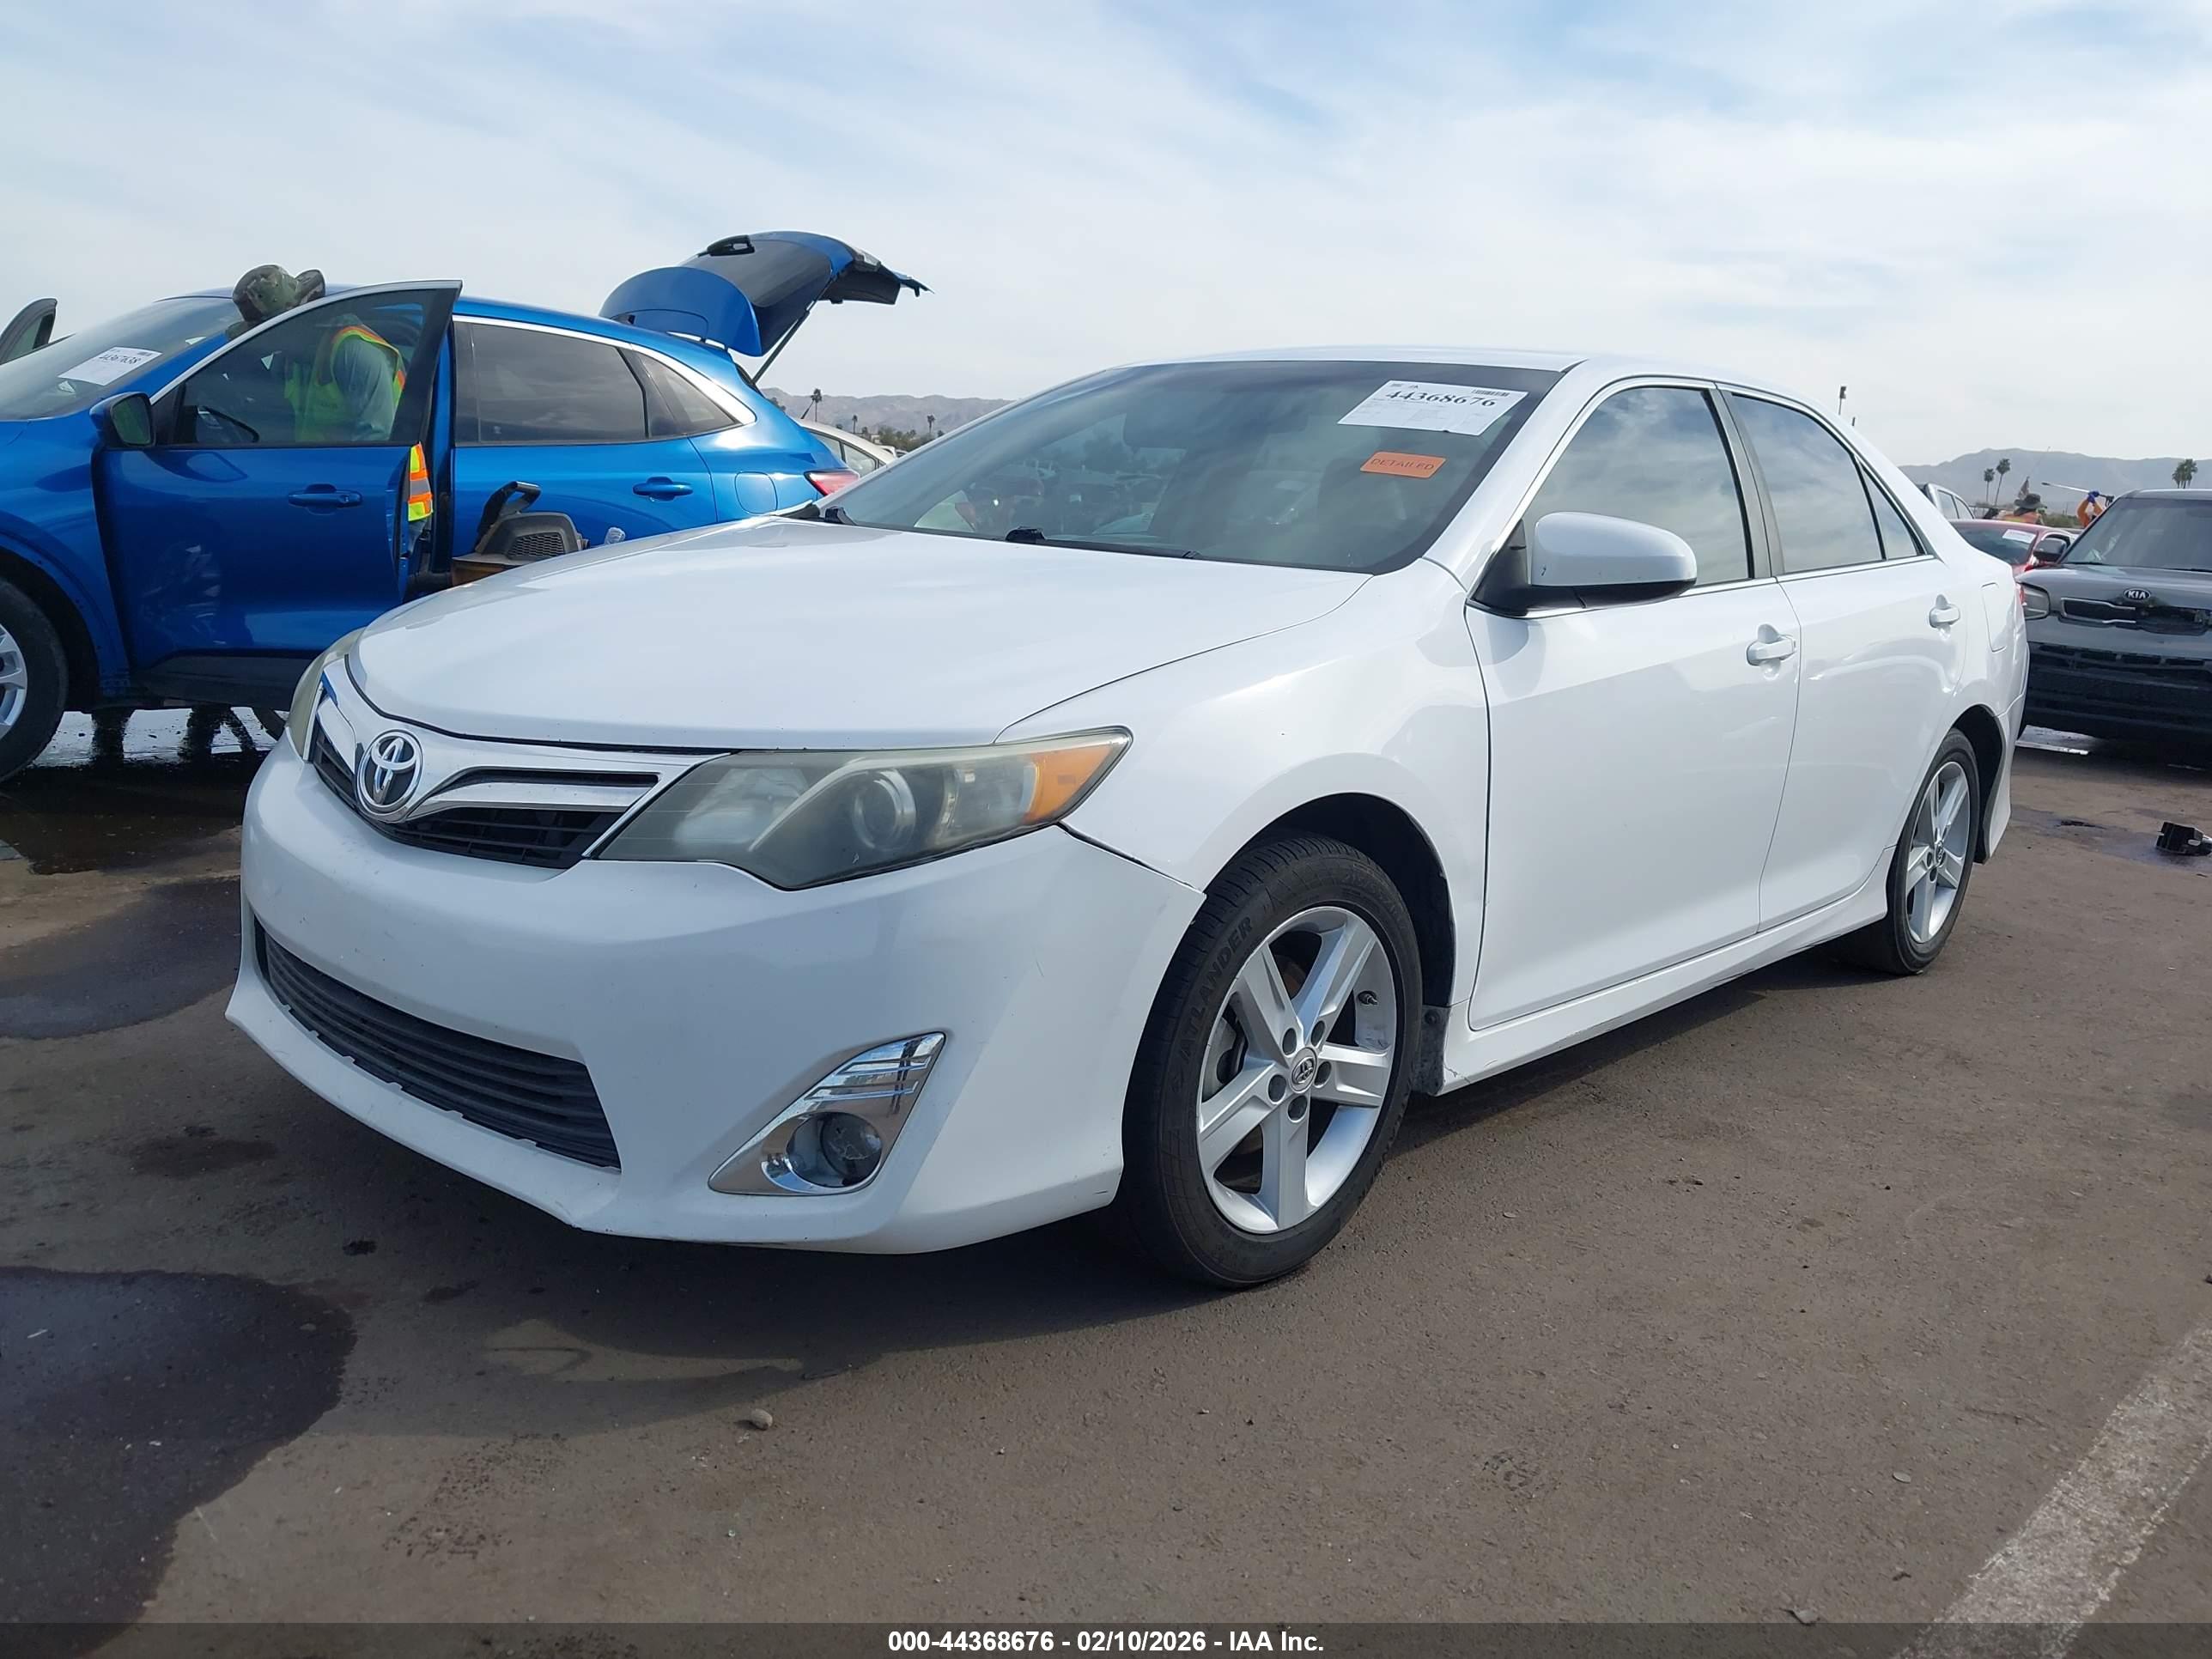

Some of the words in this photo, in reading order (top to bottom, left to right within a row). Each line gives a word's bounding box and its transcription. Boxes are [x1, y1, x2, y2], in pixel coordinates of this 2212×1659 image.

[1385, 390, 1497, 407] 44368676
[1370, 458, 1435, 470] DETAILED
[2128, 590, 2146, 599] KIA
[1178, 915, 1253, 1062] ATLANDER
